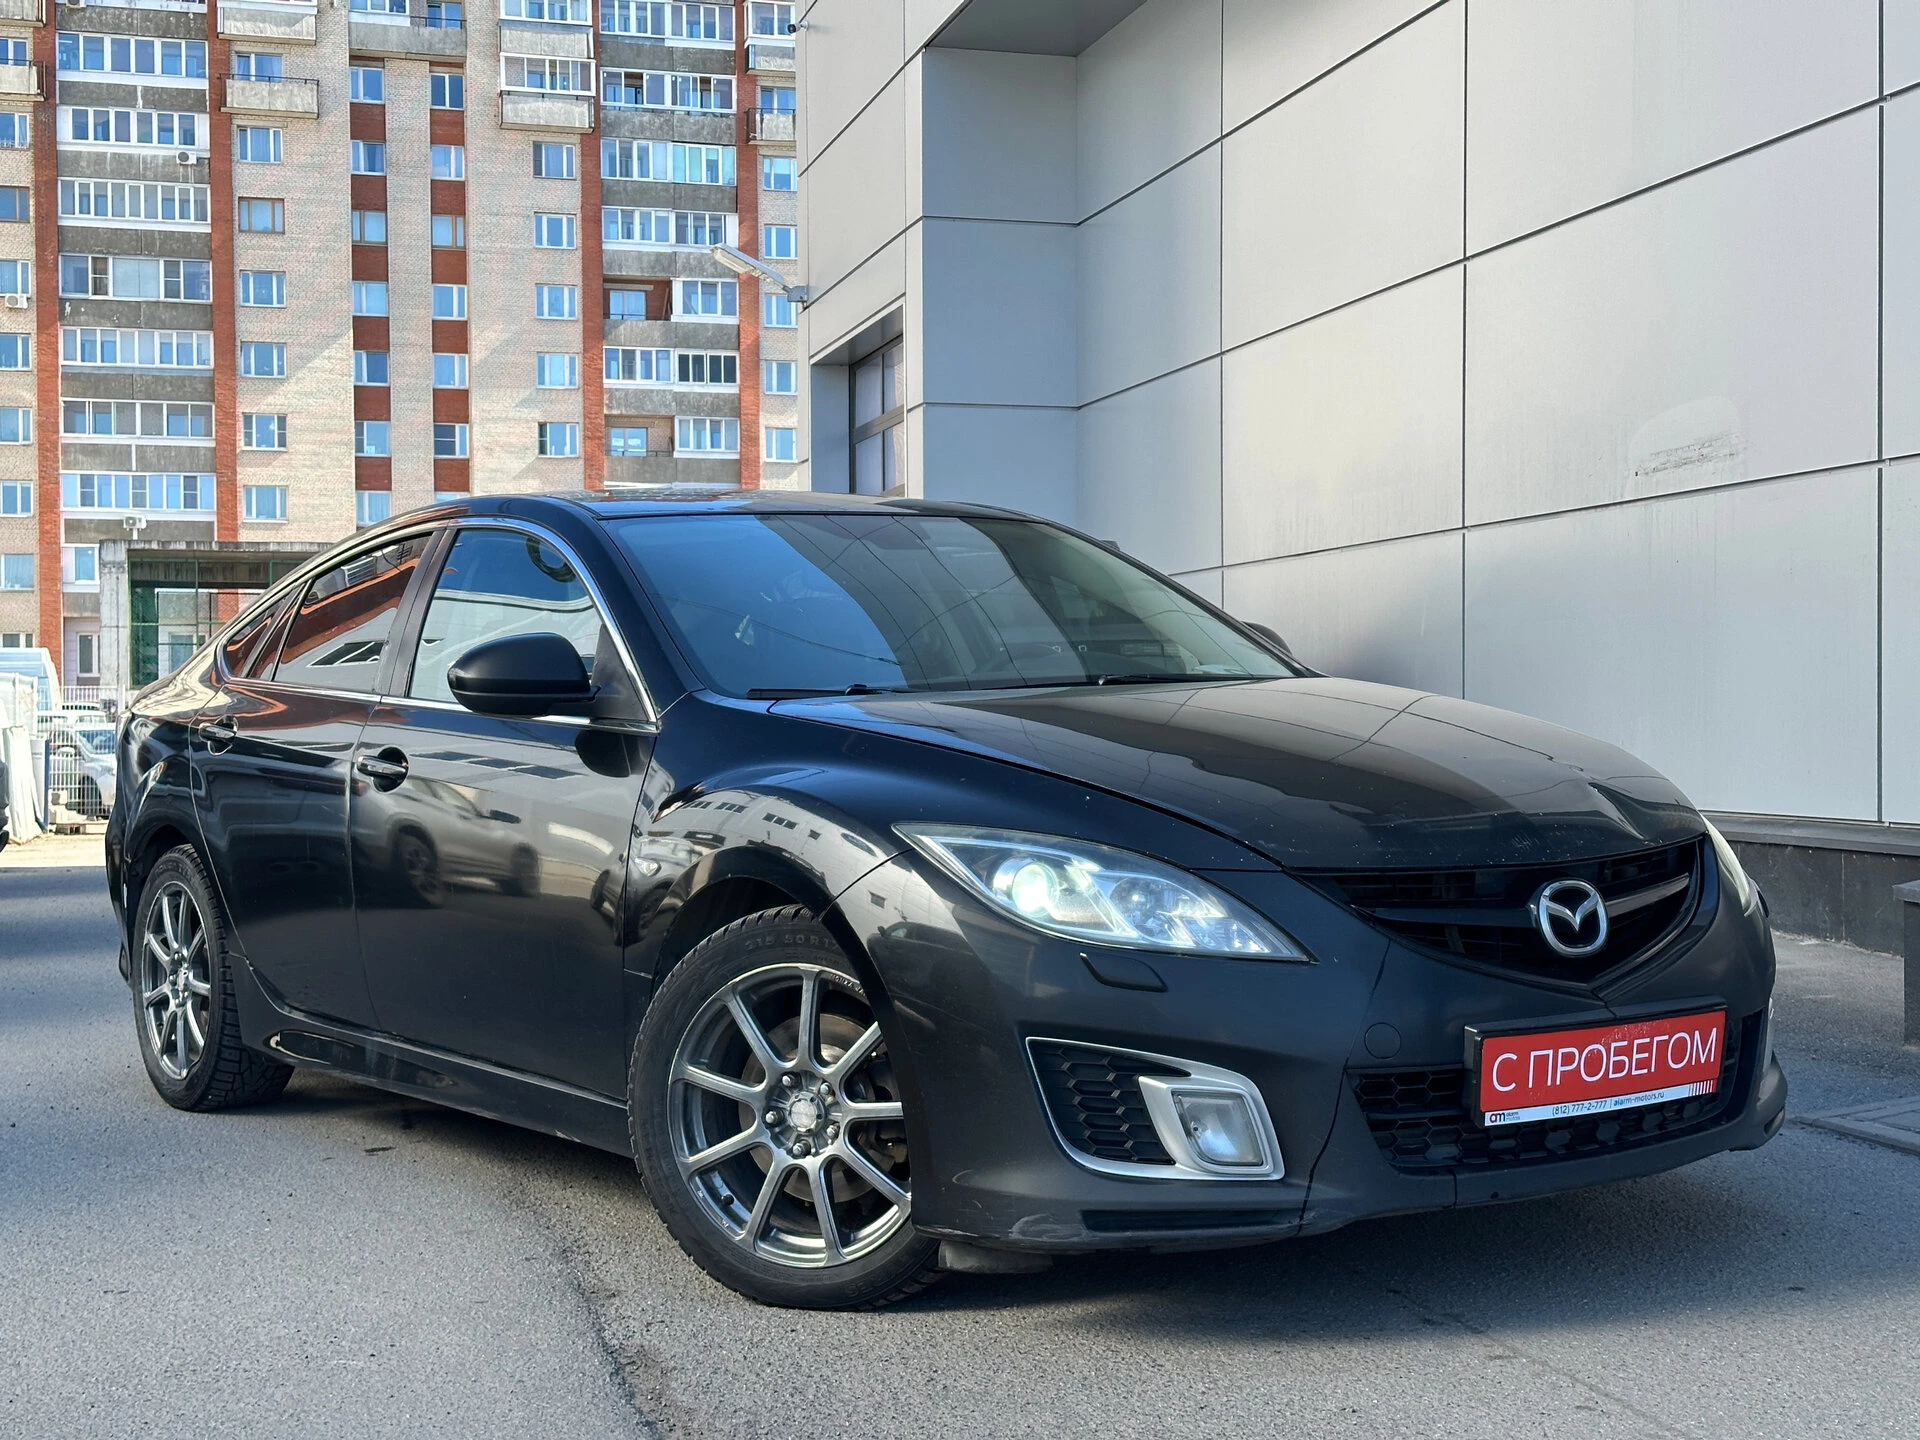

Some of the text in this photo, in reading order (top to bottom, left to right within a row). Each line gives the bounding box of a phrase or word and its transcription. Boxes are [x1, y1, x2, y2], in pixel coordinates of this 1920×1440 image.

[1492, 1027, 1718, 1092] С ПРОБЕГОМ
[1552, 1091, 1665, 1117] (812) 777-2-777 alarm-motors.ru
